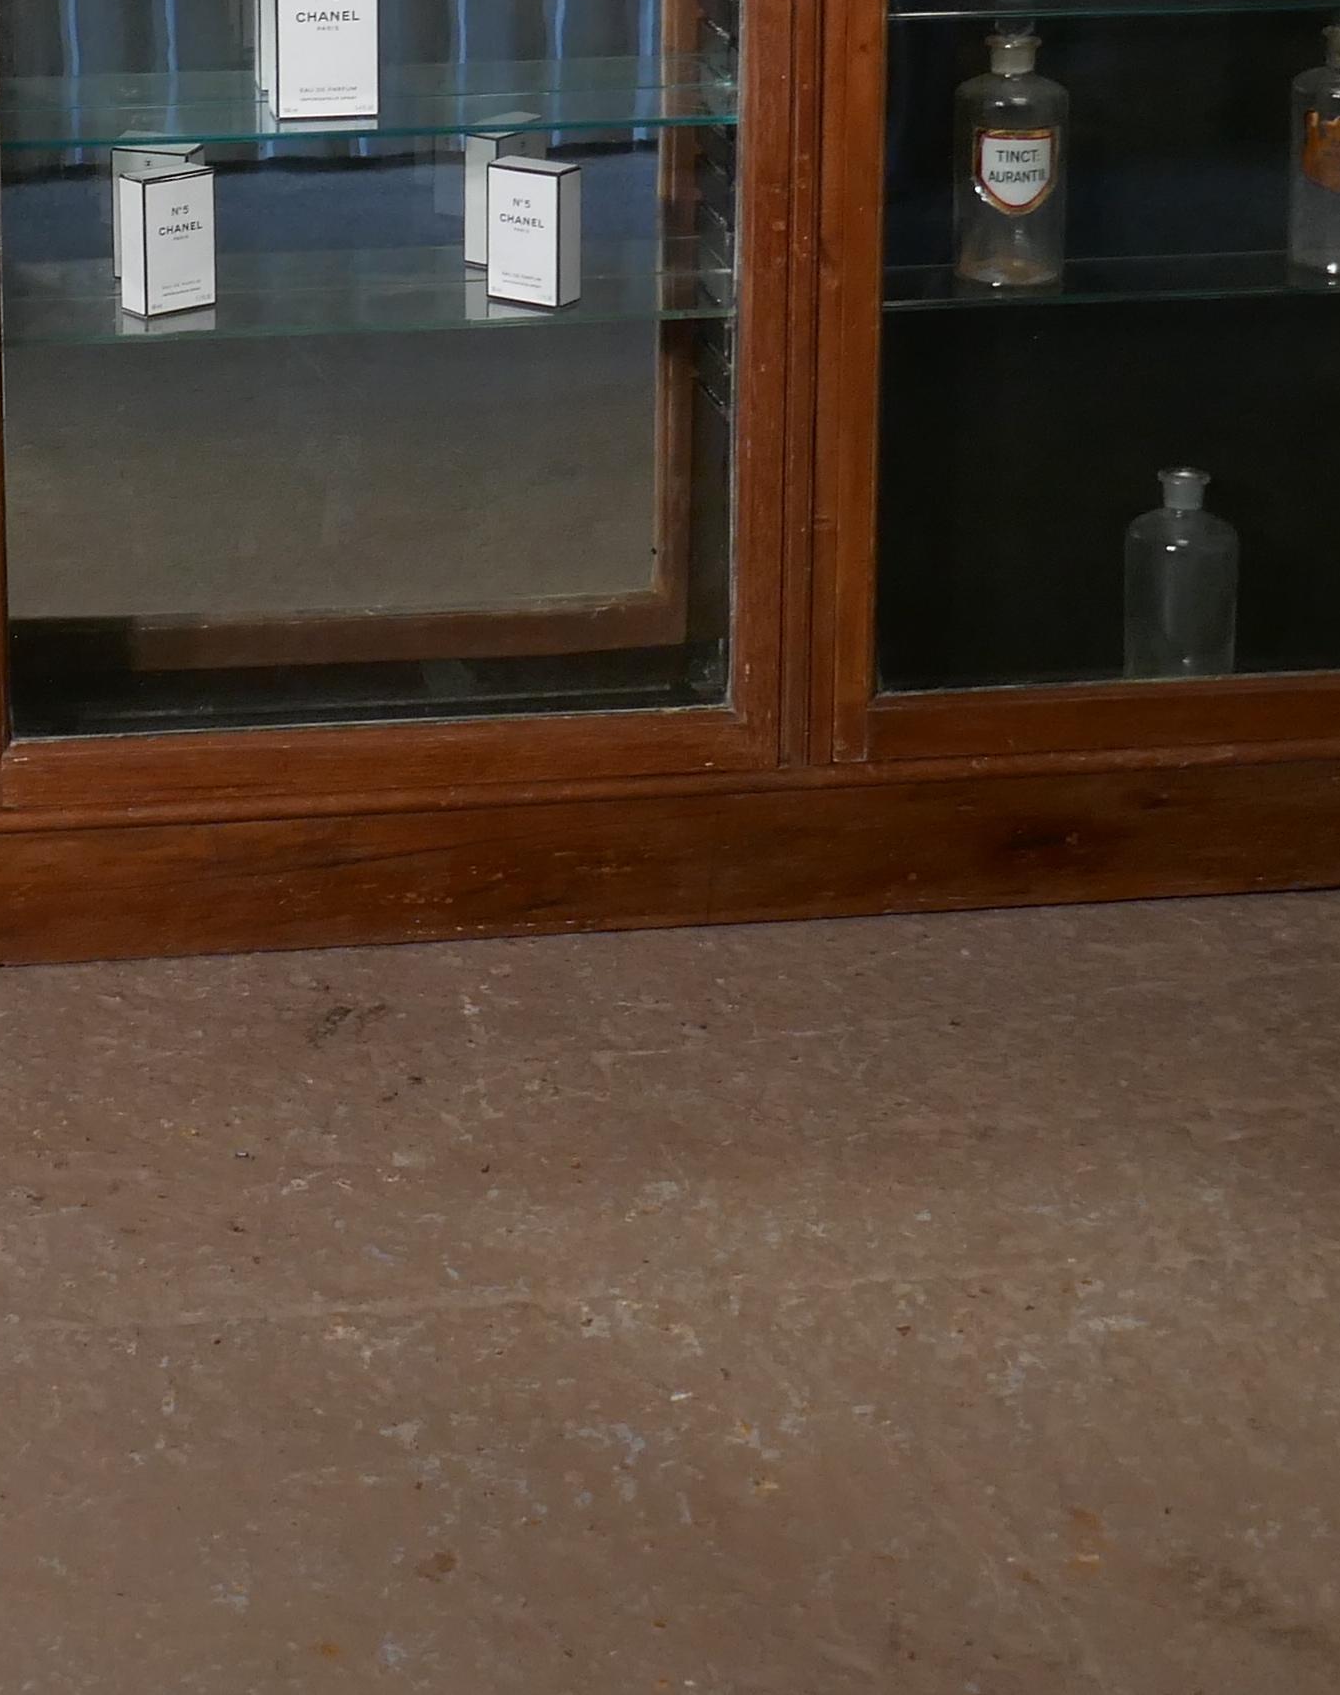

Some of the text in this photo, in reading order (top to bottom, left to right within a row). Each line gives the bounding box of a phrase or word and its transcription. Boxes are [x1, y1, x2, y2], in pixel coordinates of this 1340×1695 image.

[295, 10, 361, 23] CHANEL
[158, 220, 204, 236] CHANEL
[499, 212, 545, 229] CHANEL
